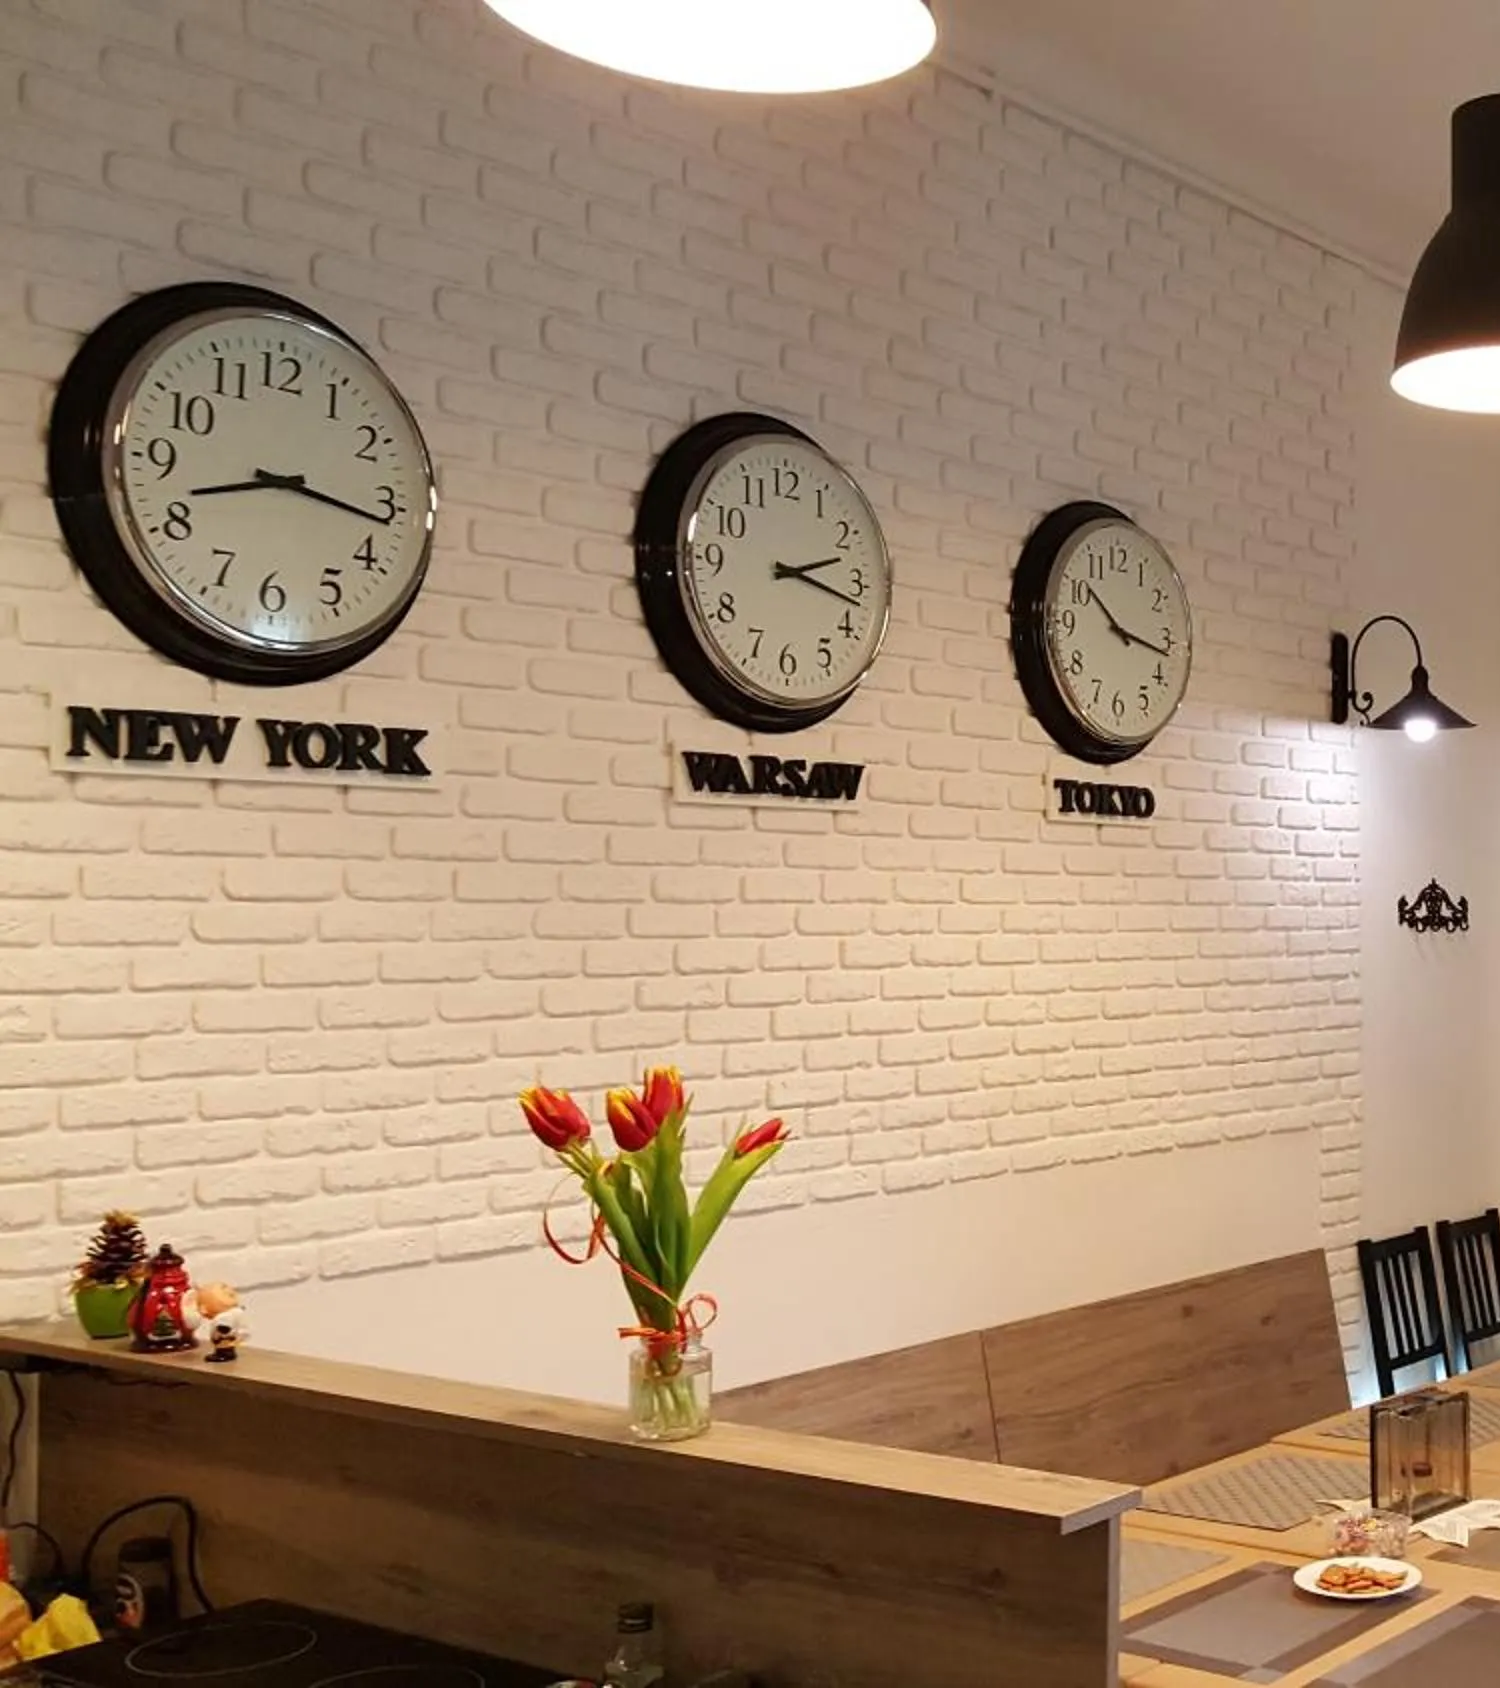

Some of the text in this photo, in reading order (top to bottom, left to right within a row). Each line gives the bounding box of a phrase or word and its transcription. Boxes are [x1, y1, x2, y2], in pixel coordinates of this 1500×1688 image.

[213, 358, 248, 400] 11
[261, 351, 303, 395] 12
[170, 391, 215, 435] 10
[325, 384, 341, 420] 1
[148, 437, 177, 480] 9
[355, 425, 378, 462] 2
[743, 475, 765, 508] 11
[773, 467, 800, 501] 12
[375, 486, 395, 524] 3
[816, 489, 824, 518] 1
[163, 501, 192, 541] 8
[717, 505, 745, 538] 10
[835, 521, 849, 549] 2
[211, 548, 237, 587] 7
[353, 534, 378, 571] 4
[705, 543, 724, 576] 9
[1089, 553, 1104, 580] 11
[1109, 546, 1128, 573] 12
[320, 568, 342, 605] 5
[849, 569, 863, 597] 3
[1138, 562, 1144, 587] 1
[259, 571, 286, 612] 6
[717, 592, 736, 623] 8
[1071, 579, 1092, 606] 10
[1152, 590, 1162, 612] 2
[837, 609, 854, 638] 4
[1062, 610, 1075, 637] 9
[1161, 627, 1171, 650] 3
[749, 628, 764, 658] 7
[817, 638, 832, 668] 5
[779, 644, 797, 676] 6
[1070, 650, 1083, 675] 8
[1152, 663, 1164, 685] 4
[1092, 679, 1102, 703] 7
[1112, 690, 1124, 717] 6
[1139, 686, 1149, 710] 5
[66, 706, 432, 776] NEW YORK
[681, 751, 866, 800] WARSAW
[1053, 778, 1156, 818] TOKYO
